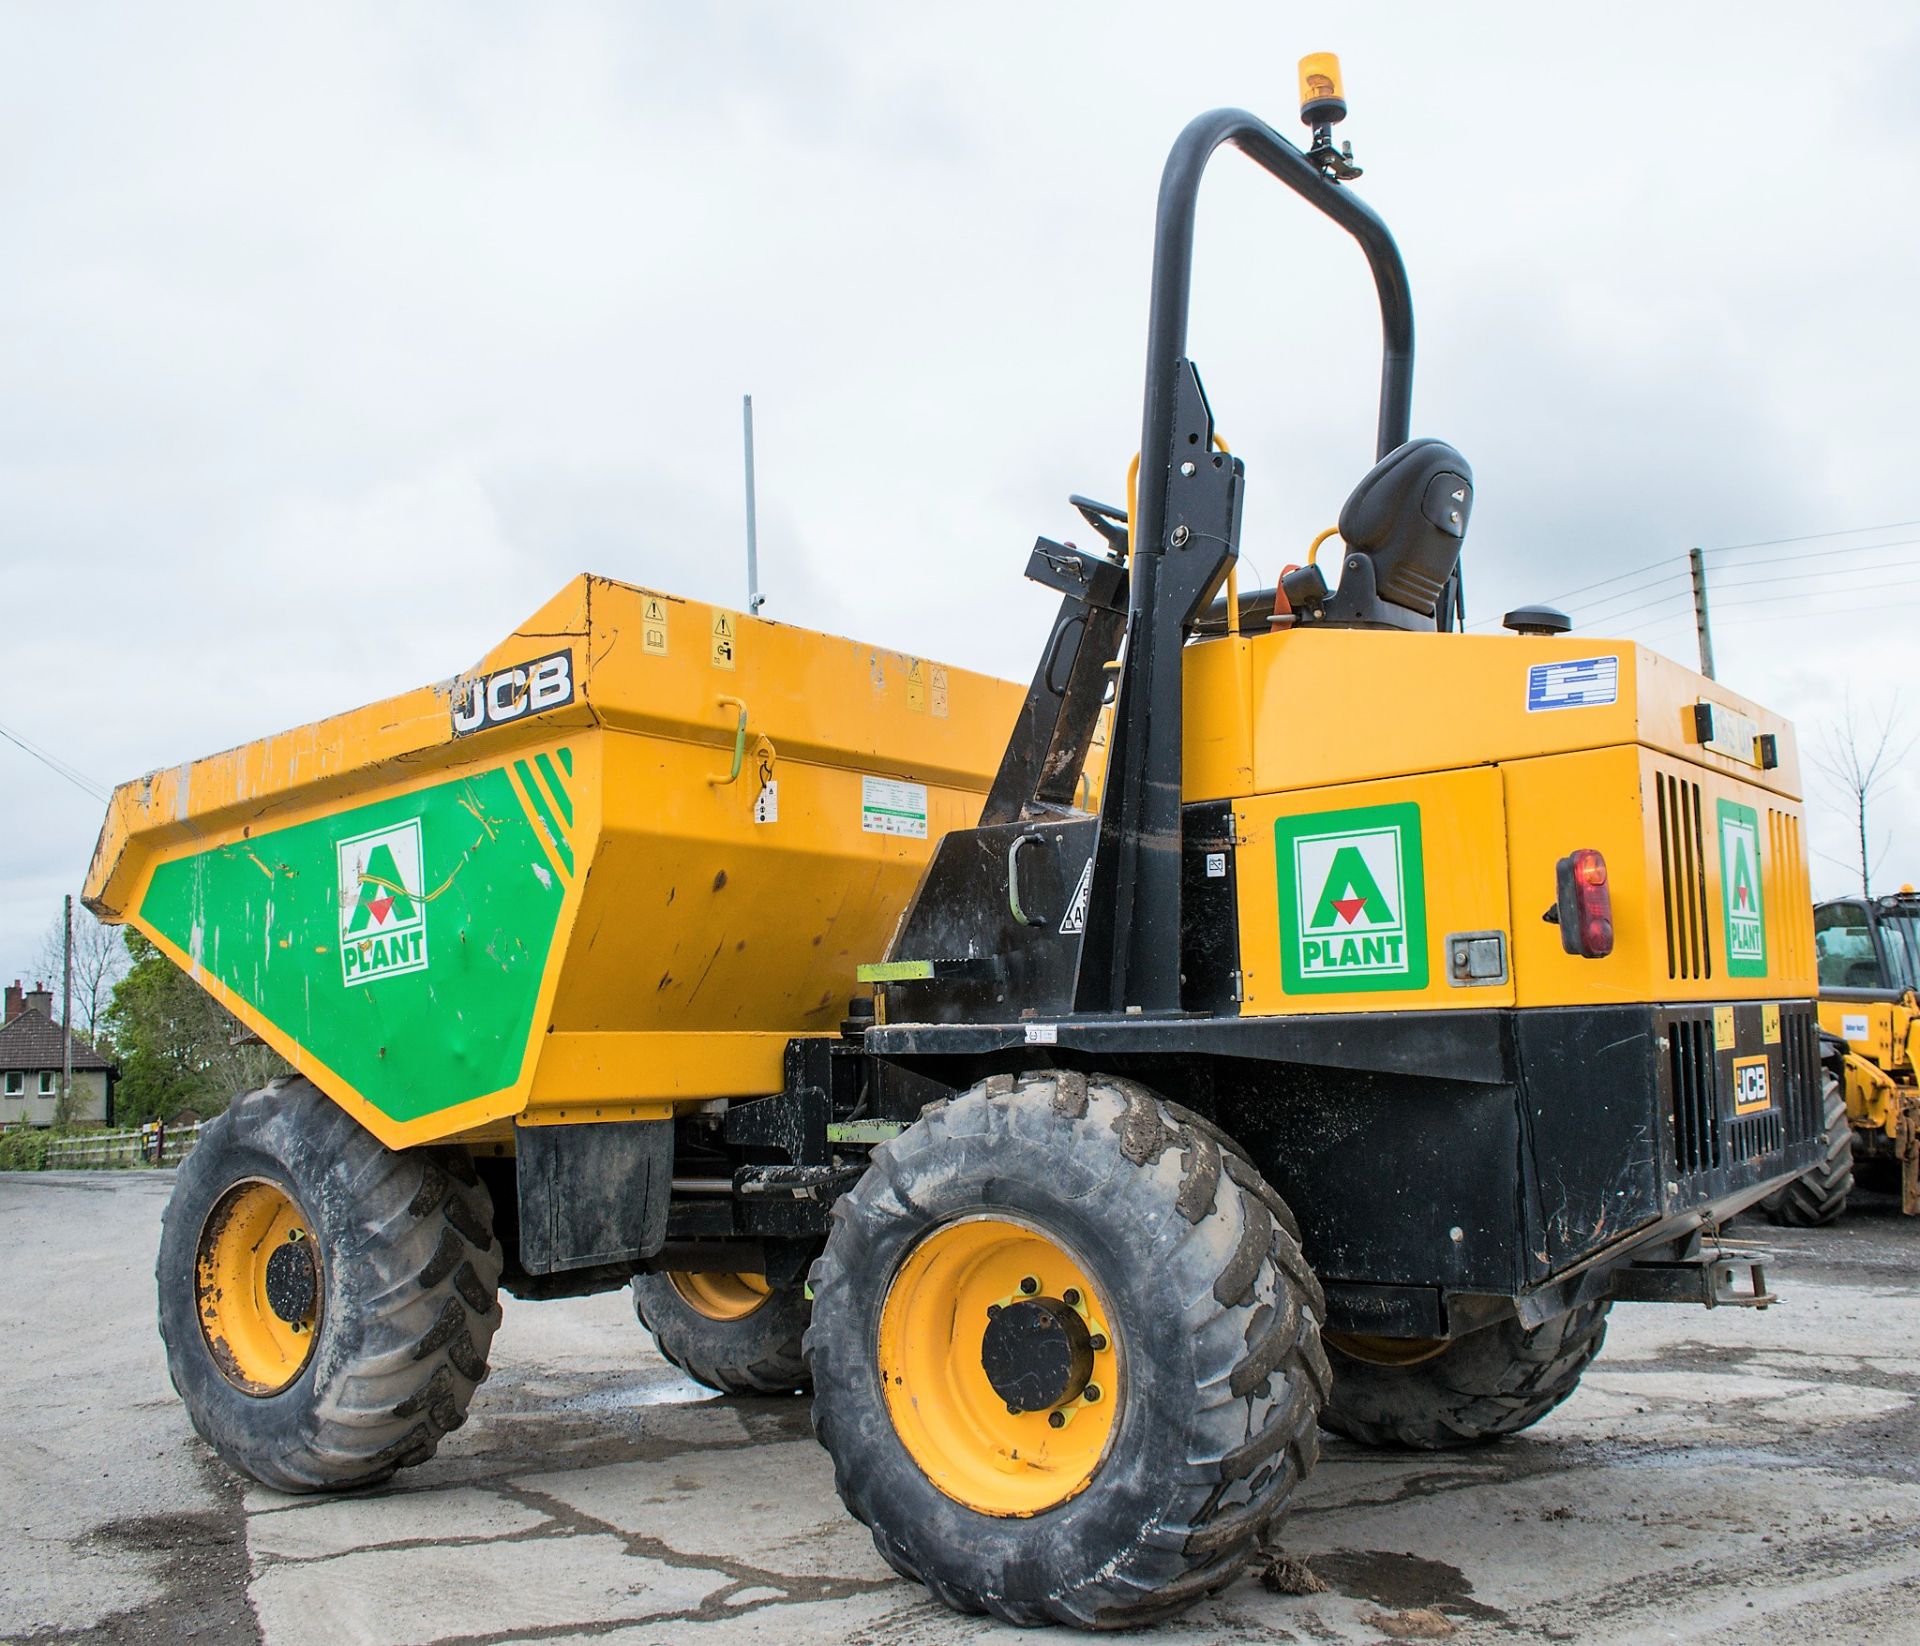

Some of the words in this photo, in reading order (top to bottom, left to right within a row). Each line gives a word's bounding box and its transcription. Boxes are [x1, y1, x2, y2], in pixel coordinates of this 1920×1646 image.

[454, 656, 571, 732] JCB
[348, 843, 417, 934] A
[1309, 846, 1396, 929] A
[1732, 836, 1757, 913] A
[343, 930, 424, 977] PLANT
[1302, 935, 1404, 969] PLANT
[1731, 922, 1760, 951] PLANT
[1738, 1066, 1767, 1102] JCB
